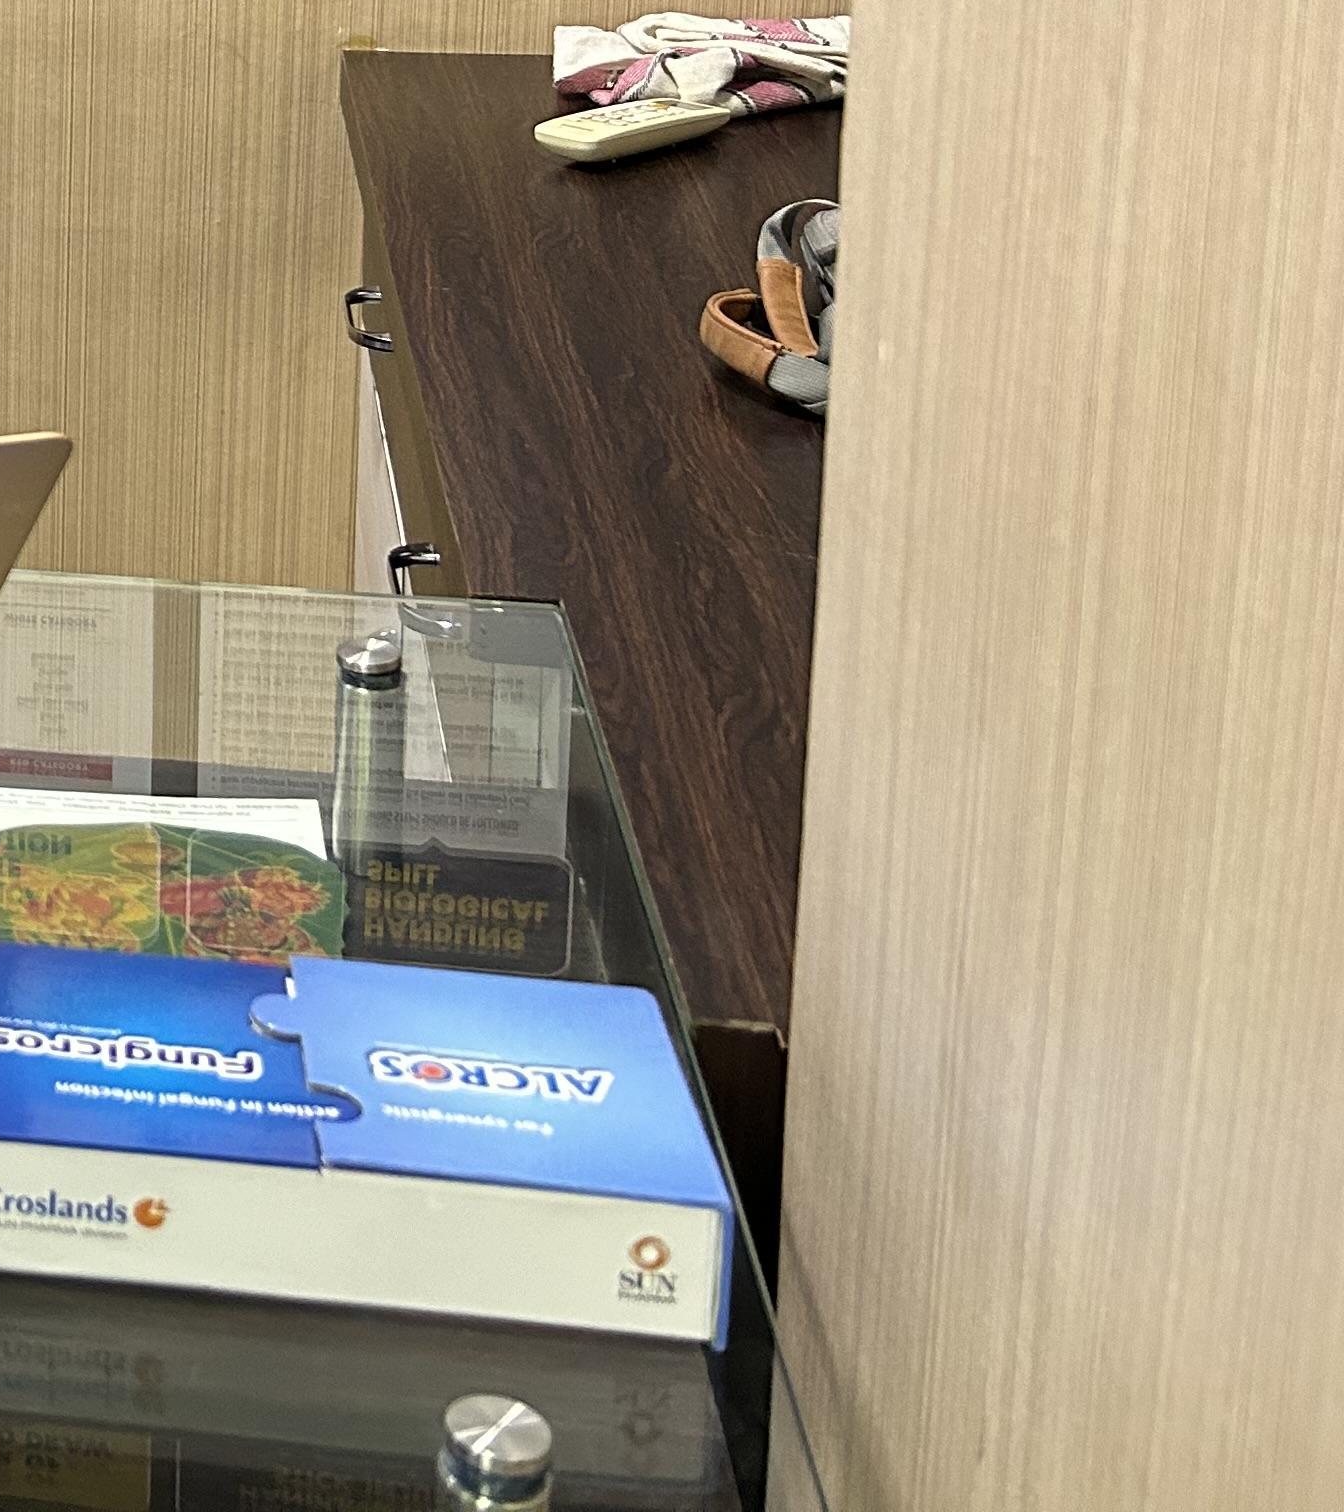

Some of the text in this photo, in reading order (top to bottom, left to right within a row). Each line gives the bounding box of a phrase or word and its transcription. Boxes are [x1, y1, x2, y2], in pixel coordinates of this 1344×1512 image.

[371, 1053, 605, 1097] ALCROS
[55, 1082, 340, 1120] action in Fungal infection
